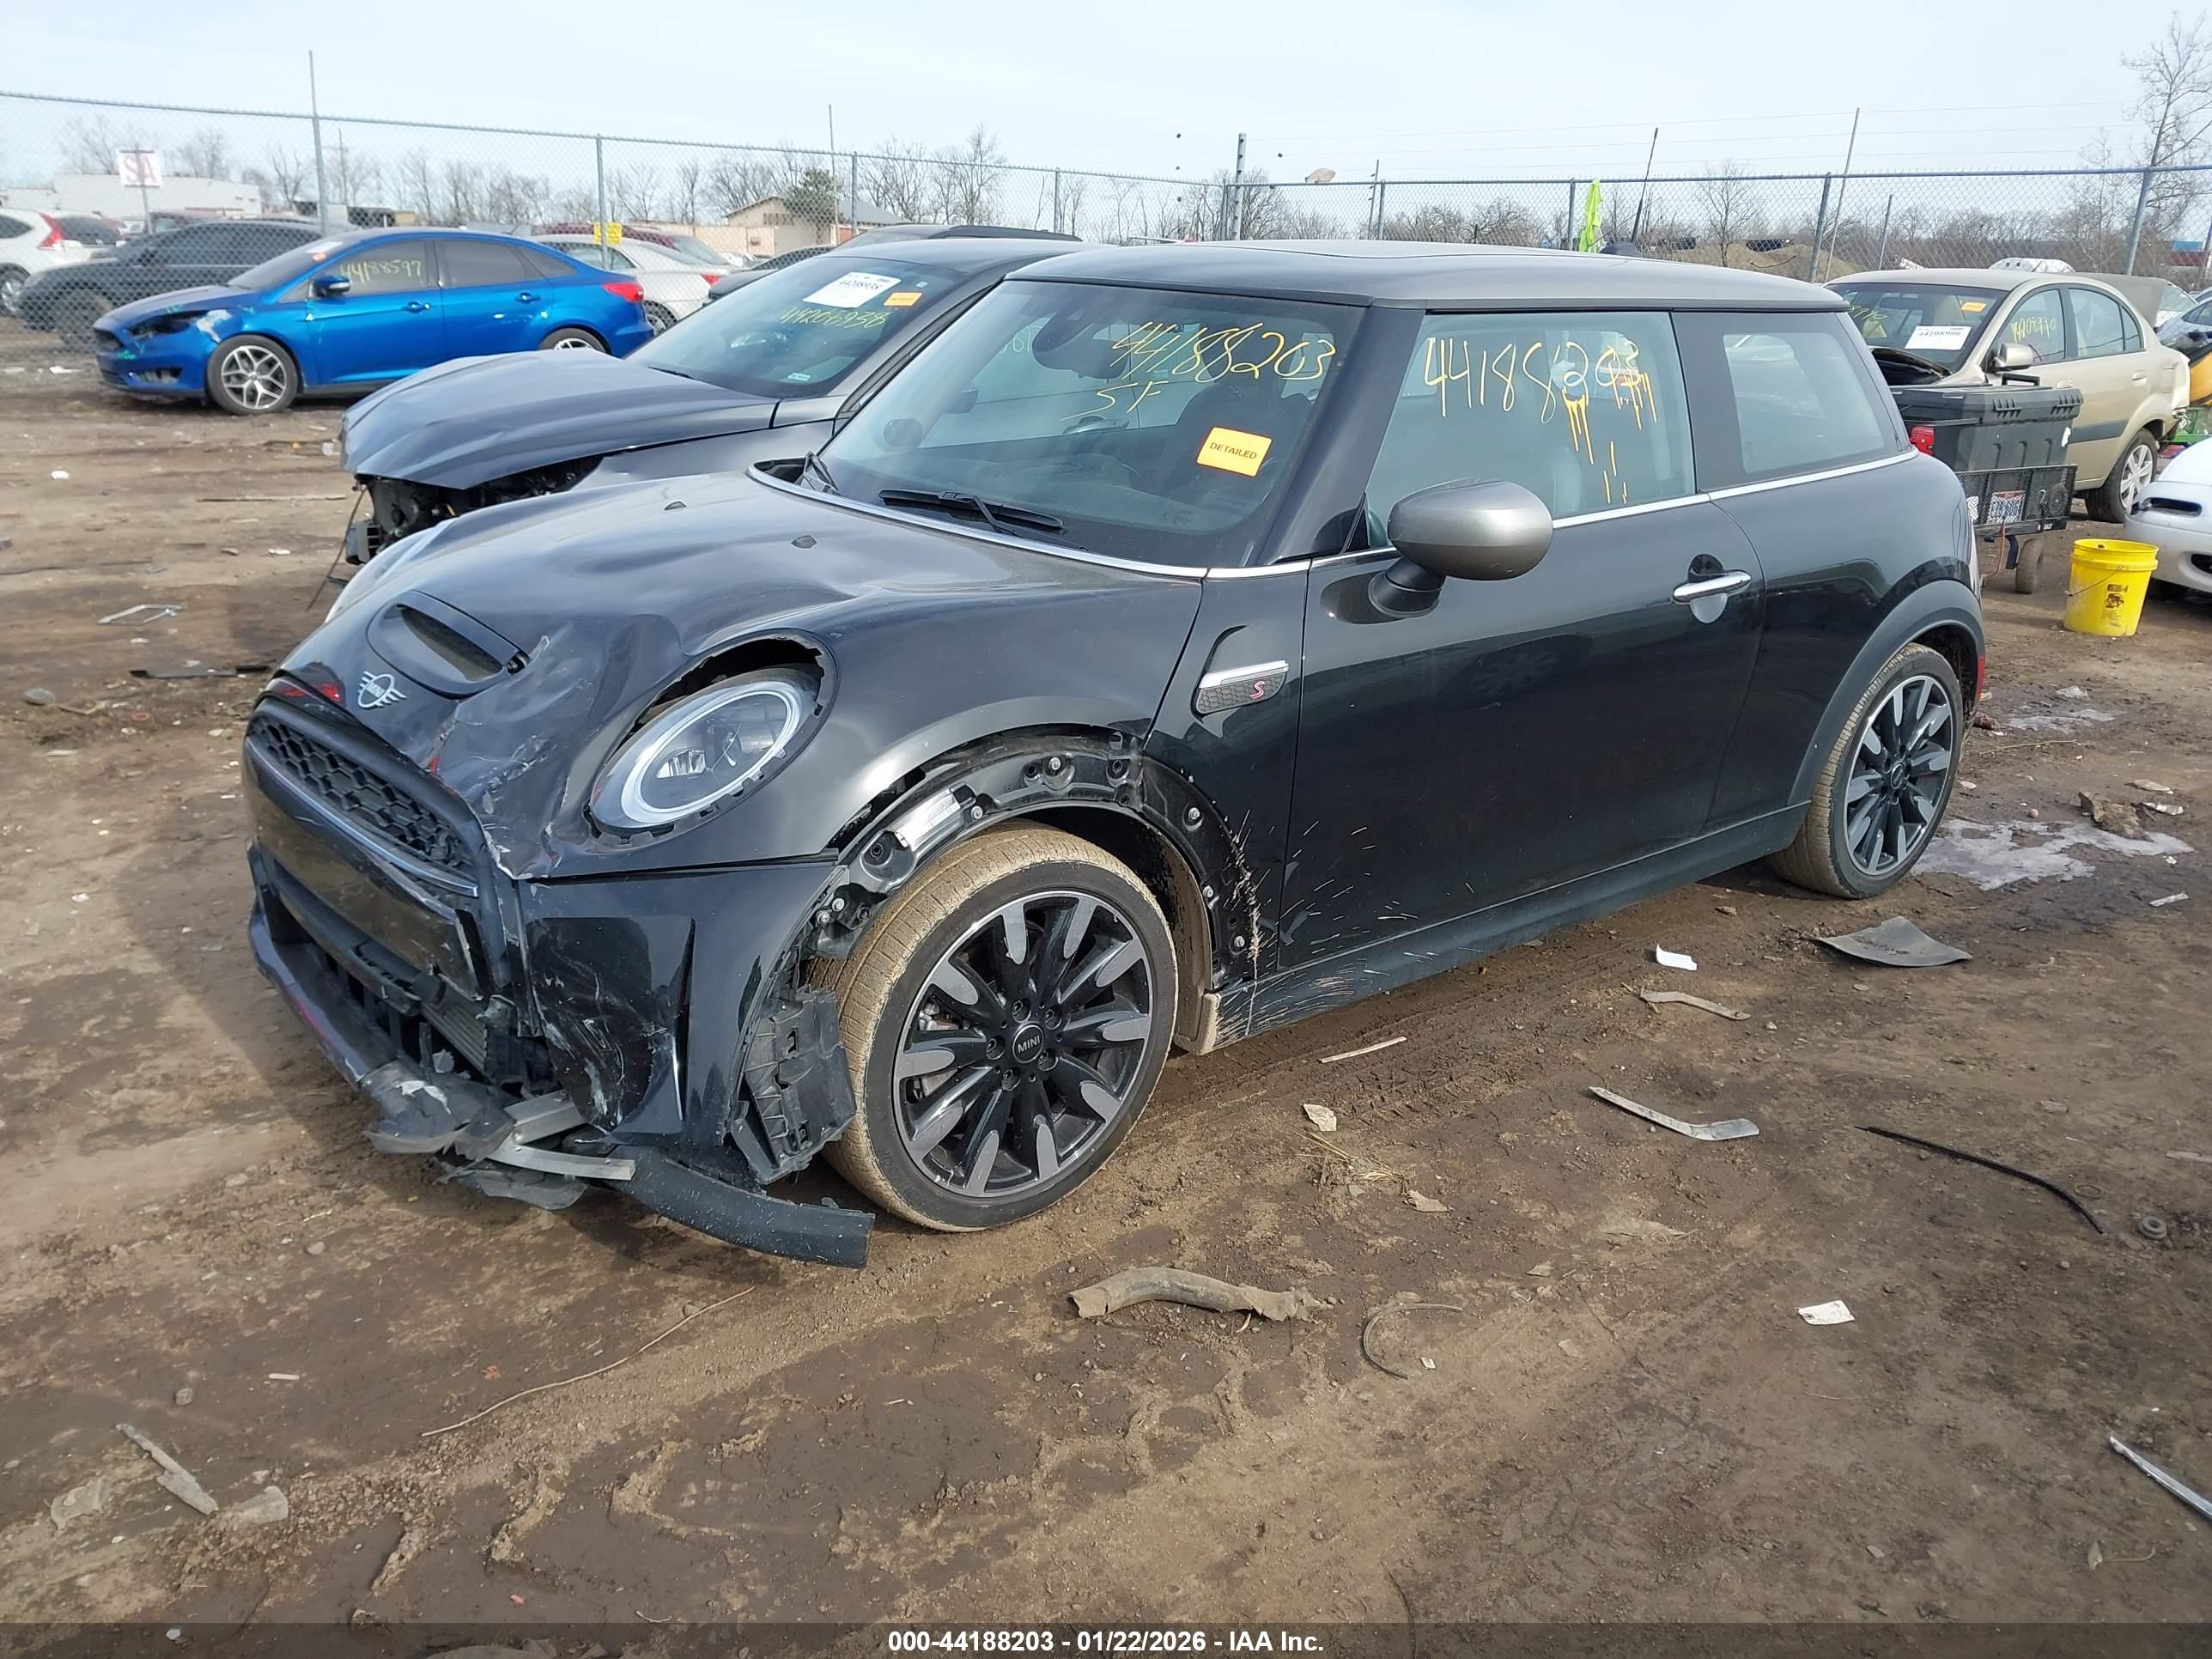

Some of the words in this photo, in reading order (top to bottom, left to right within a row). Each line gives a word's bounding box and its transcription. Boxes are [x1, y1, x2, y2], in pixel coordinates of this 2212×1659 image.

[339, 258, 422, 283] 44188597
[1109, 321, 1336, 383] 44188203
[1424, 337, 1640, 424] 44188203
[1208, 441, 1258, 460] DETAILED
[365, 681, 386, 698] MINI
[1249, 679, 1266, 700] S
[1017, 1034, 1041, 1054] MINI
